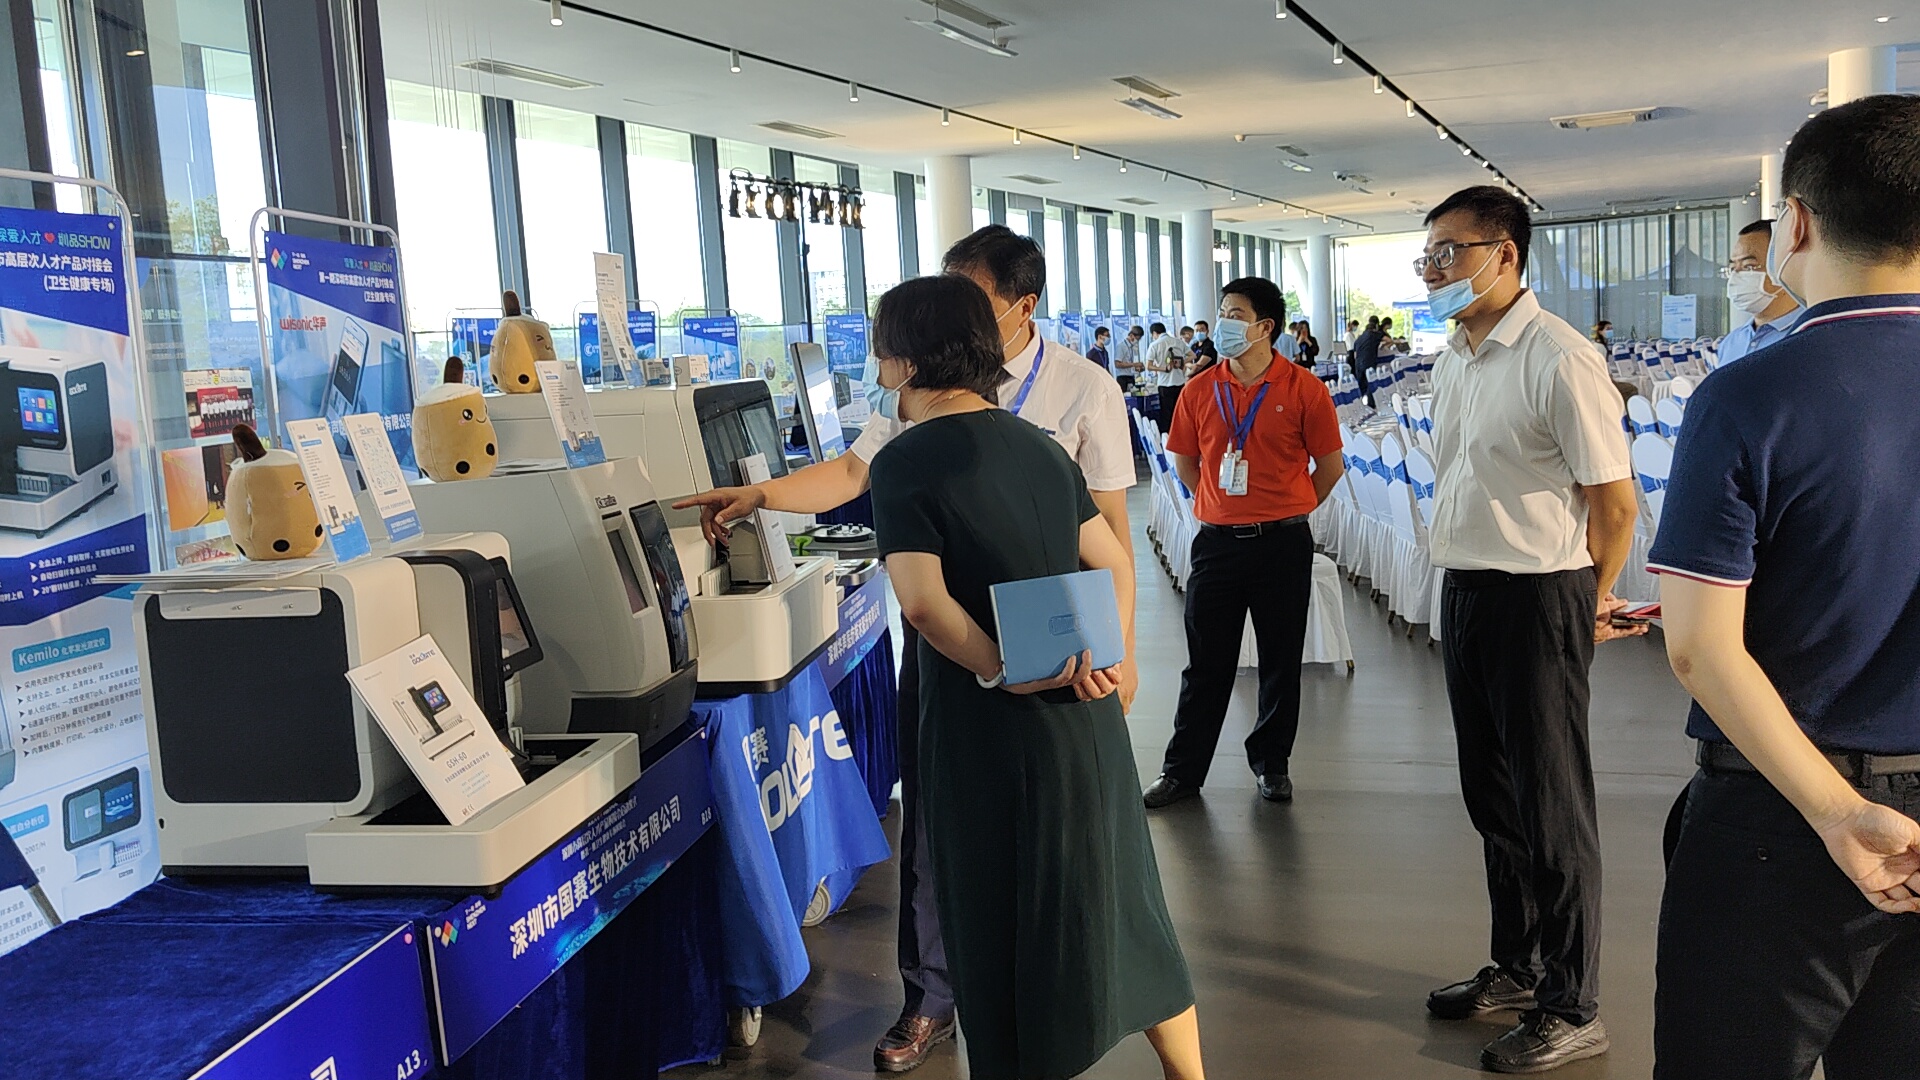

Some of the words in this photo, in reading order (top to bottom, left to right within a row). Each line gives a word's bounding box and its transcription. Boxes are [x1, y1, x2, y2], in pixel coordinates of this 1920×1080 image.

[44, 275, 115, 294] (卫生健康专场)
[18, 647, 60, 667] Kemilo
[446, 752, 468, 769] GSH-60
[509, 795, 682, 959] 深圳市国赛生物技术有限公司
[397, 1050, 421, 1080] A13
